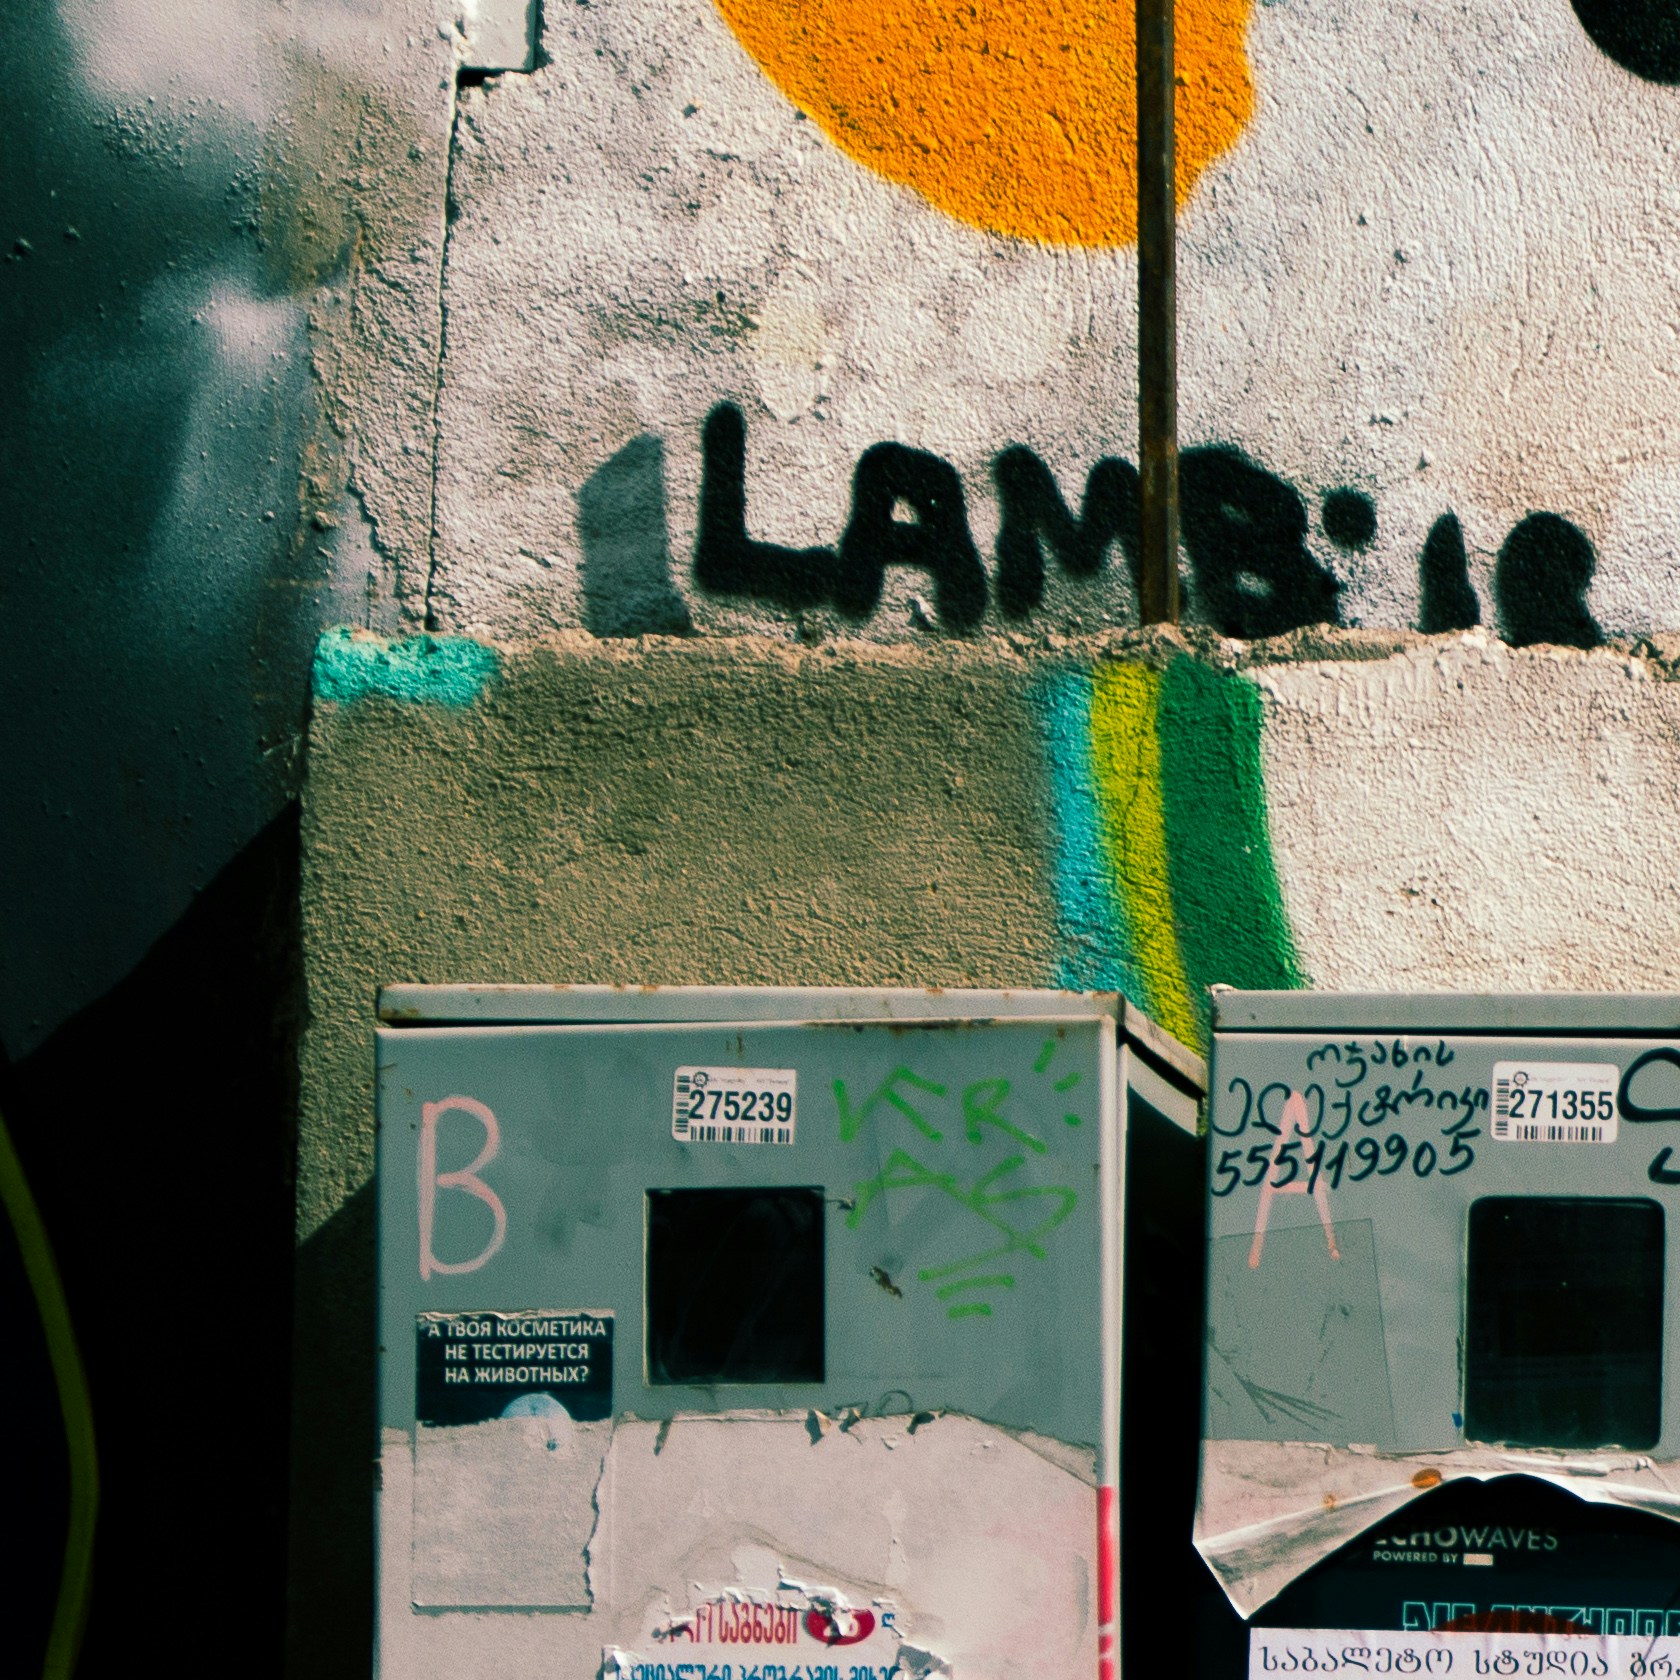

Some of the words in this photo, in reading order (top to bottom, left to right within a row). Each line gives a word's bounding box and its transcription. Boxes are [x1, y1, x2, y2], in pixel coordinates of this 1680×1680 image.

[688, 1089, 791, 1122] 275239
[1509, 1088, 1613, 1121] 271355
[1211, 1127, 1482, 1197] 555119905
[428, 1324, 440, 1337] А
[497, 1320, 606, 1337] КОСМЕТИКА
[445, 1344, 467, 1360] НЕ
[472, 1343, 589, 1360] ТЕСТИРУЕТСЯ
[445, 1367, 470, 1383] НА
[475, 1366, 589, 1383] ЖИВОТНЫХ?
[1373, 1551, 1438, 1562] POWERED
[1442, 1552, 1459, 1563] BY
[1261, 1646, 1454, 1674] საბალეტო
[1473, 1649, 1609, 1677] სტუდია
